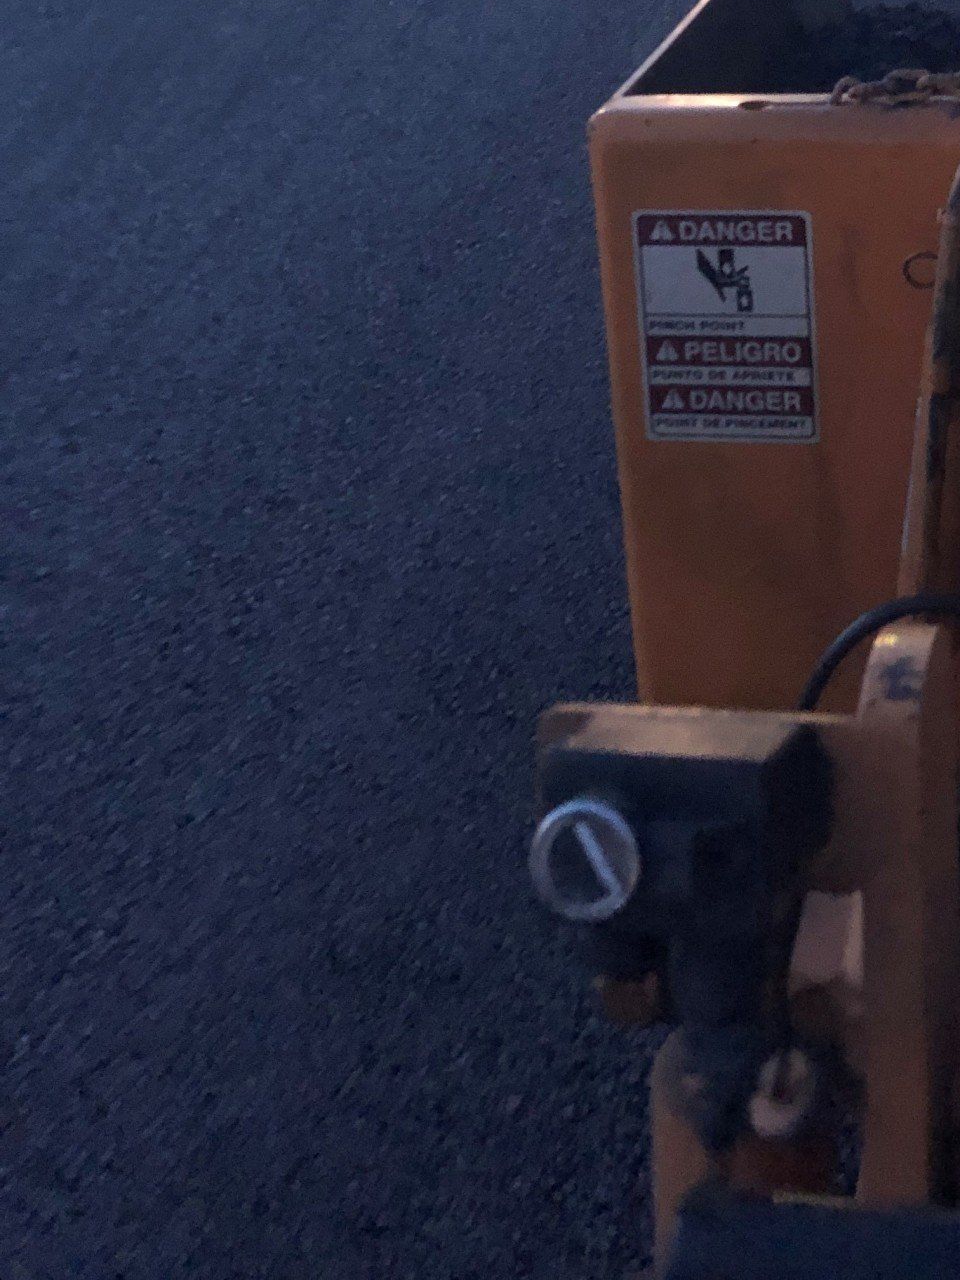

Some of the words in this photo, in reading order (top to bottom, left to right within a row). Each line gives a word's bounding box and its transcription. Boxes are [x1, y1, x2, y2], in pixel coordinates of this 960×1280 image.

[678, 220, 794, 242] DANGER
[684, 341, 802, 362] PELIGRO
[689, 390, 801, 411] DANGER
